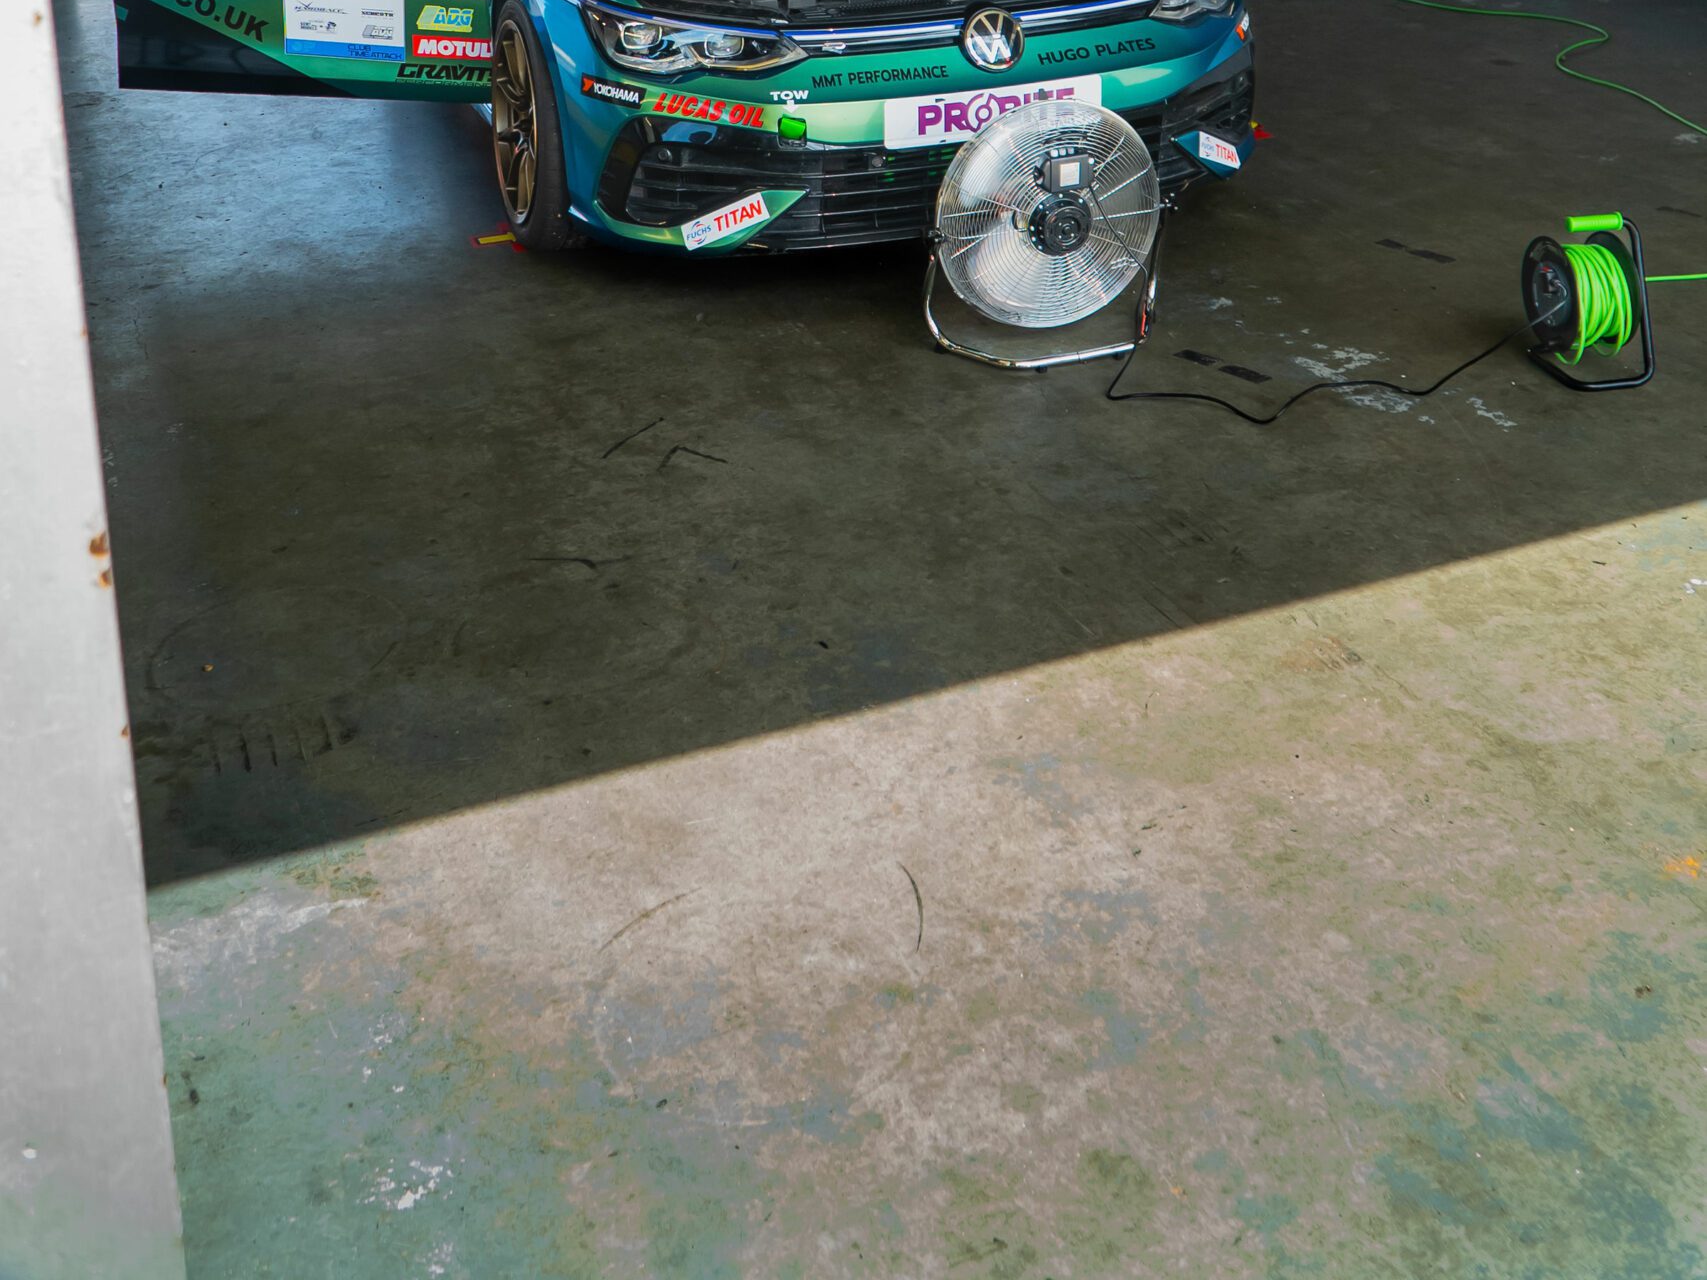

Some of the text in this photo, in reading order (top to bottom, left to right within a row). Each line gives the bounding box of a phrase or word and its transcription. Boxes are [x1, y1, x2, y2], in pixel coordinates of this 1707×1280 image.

[417, 39, 493, 57] MOTUL
[1038, 37, 1156, 66] HUGO PLATES
[397, 63, 492, 81] GRAVIT
[812, 65, 948, 89] MMT PERFORMANCE
[593, 83, 640, 104] YOKOHAMA
[770, 90, 810, 102] TOW
[653, 93, 765, 127] LUCAS OIL
[1216, 143, 1238, 164] TITAN
[686, 200, 762, 240] FUCHS TITAN
